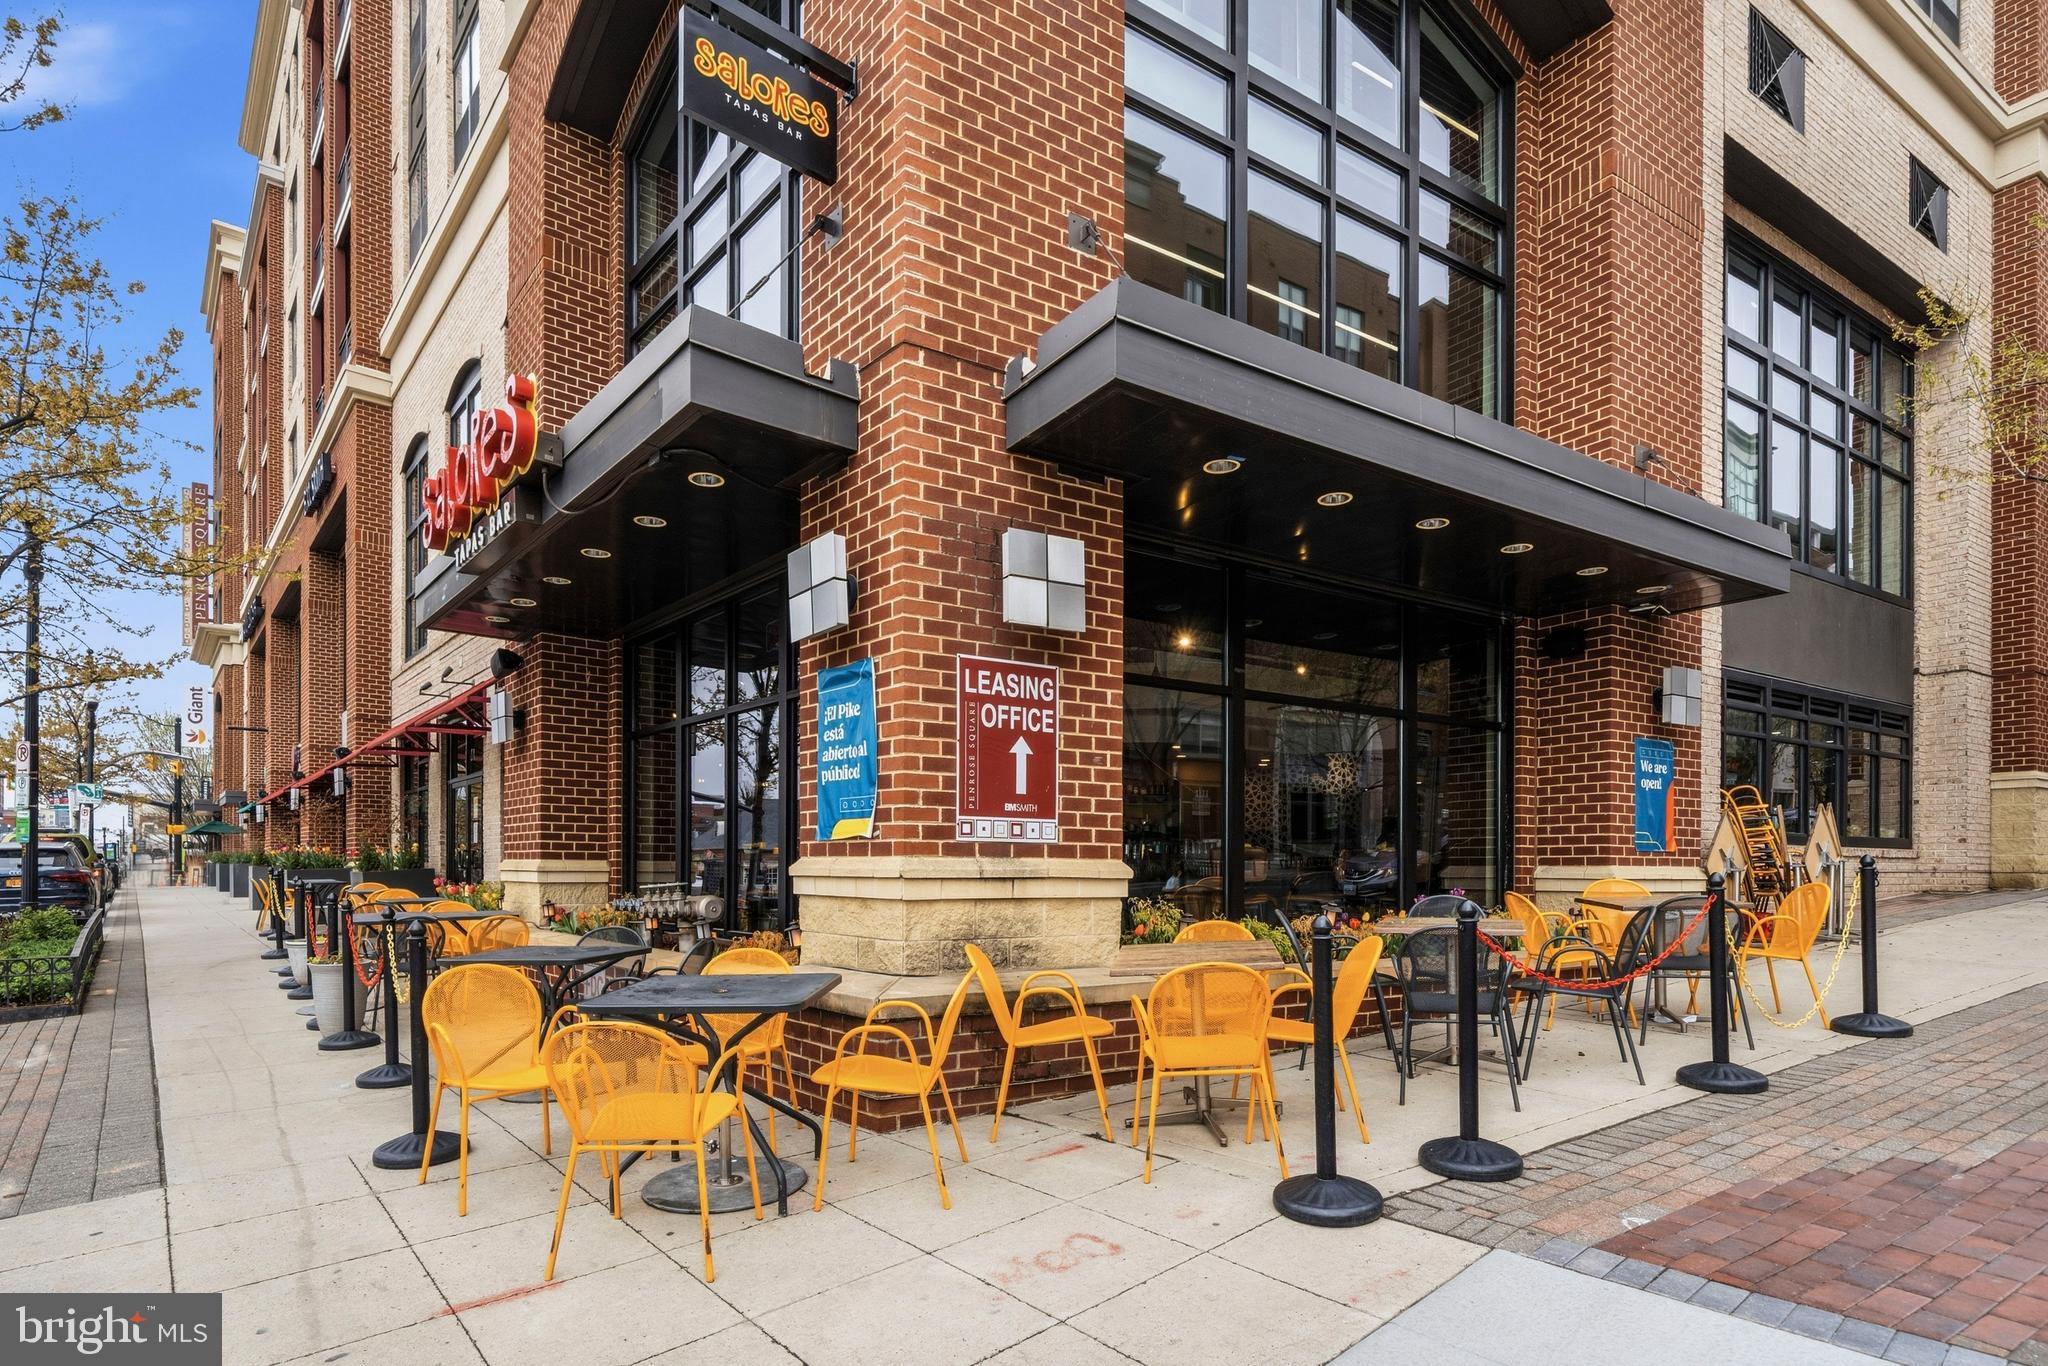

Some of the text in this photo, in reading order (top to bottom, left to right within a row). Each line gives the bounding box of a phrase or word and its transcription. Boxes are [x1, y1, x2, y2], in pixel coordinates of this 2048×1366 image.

[724, 93, 803, 141] TAPAS BAR
[195, 488, 206, 550] SQURE
[454, 501, 511, 568] TAPAS BAR
[964, 668, 1054, 702] LEASING
[188, 686, 203, 724] Giant
[838, 702, 861, 719] Pike
[981, 703, 1054, 734] OFFICE
[823, 723, 845, 742] está
[822, 740, 868, 762] abierto al
[968, 701, 976, 809] PENROSE SQUARE
[1640, 759, 1668, 774] We are
[1640, 778, 1662, 791] open!
